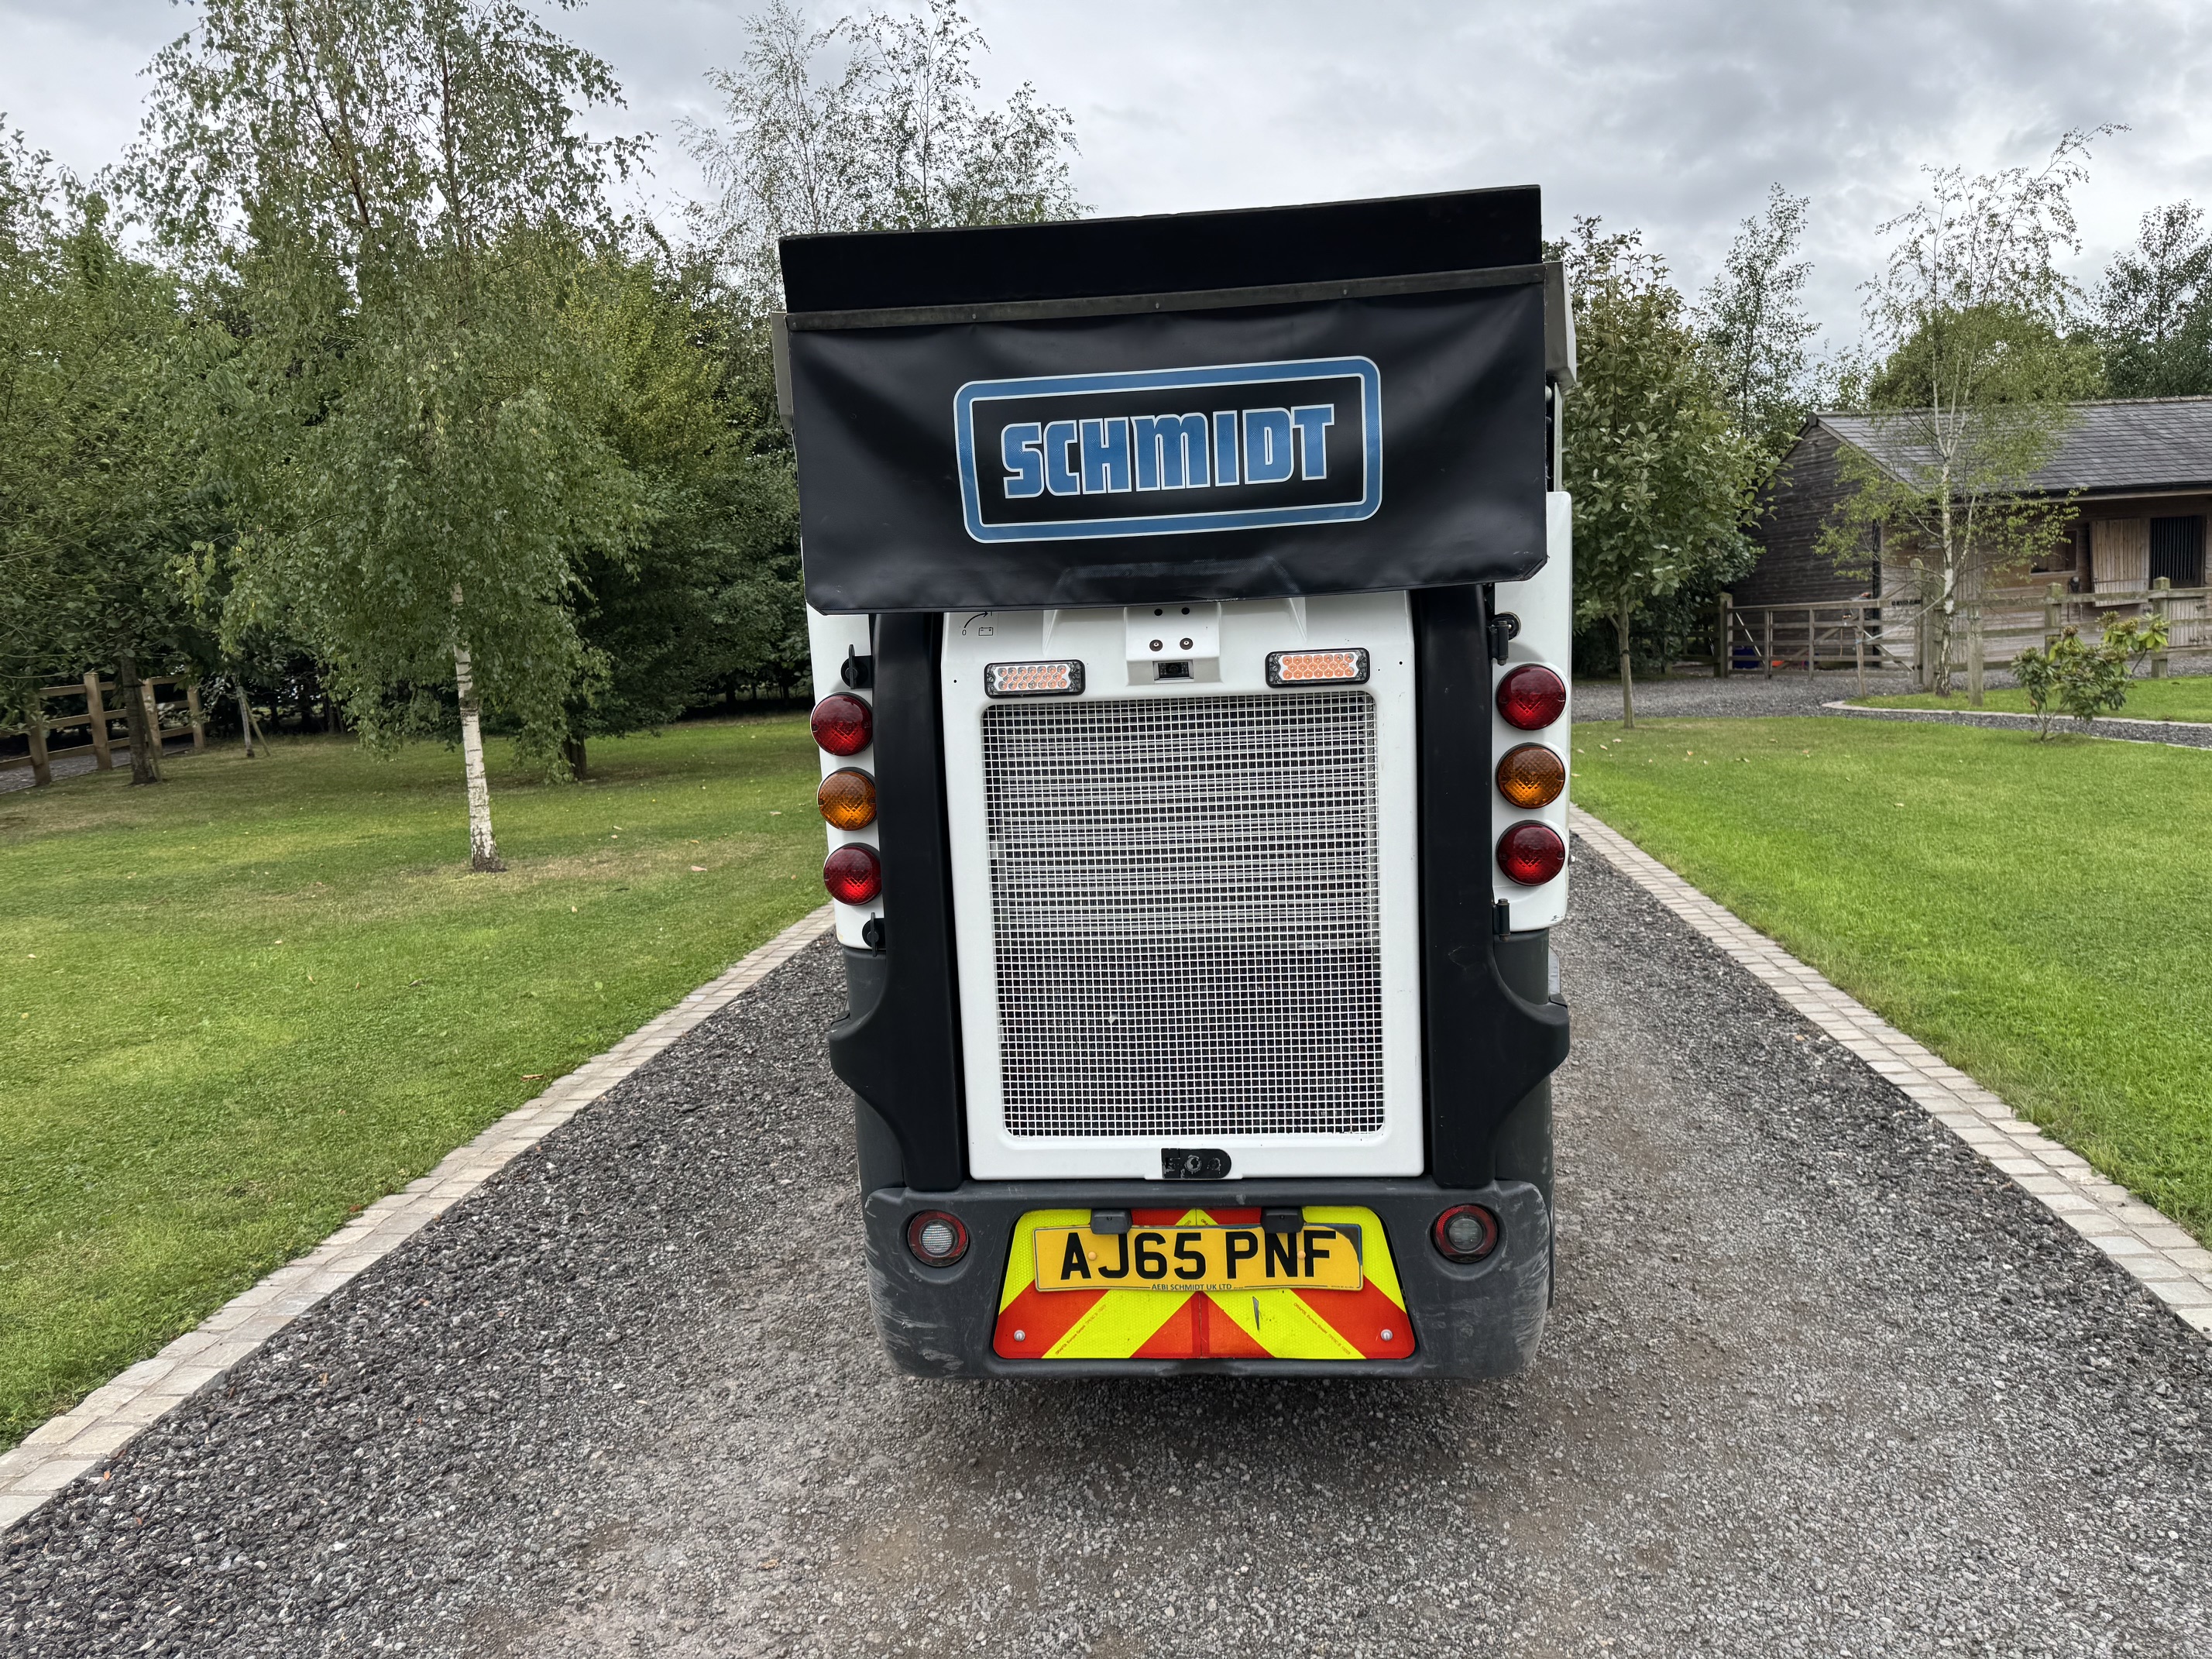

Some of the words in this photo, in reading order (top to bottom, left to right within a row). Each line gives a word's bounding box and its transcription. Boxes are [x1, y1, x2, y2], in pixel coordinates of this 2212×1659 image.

[1001, 404, 1334, 499] SCHMIDT
[1060, 1232, 1206, 1279] AJ65
[1225, 1230, 1336, 1279] PNF
